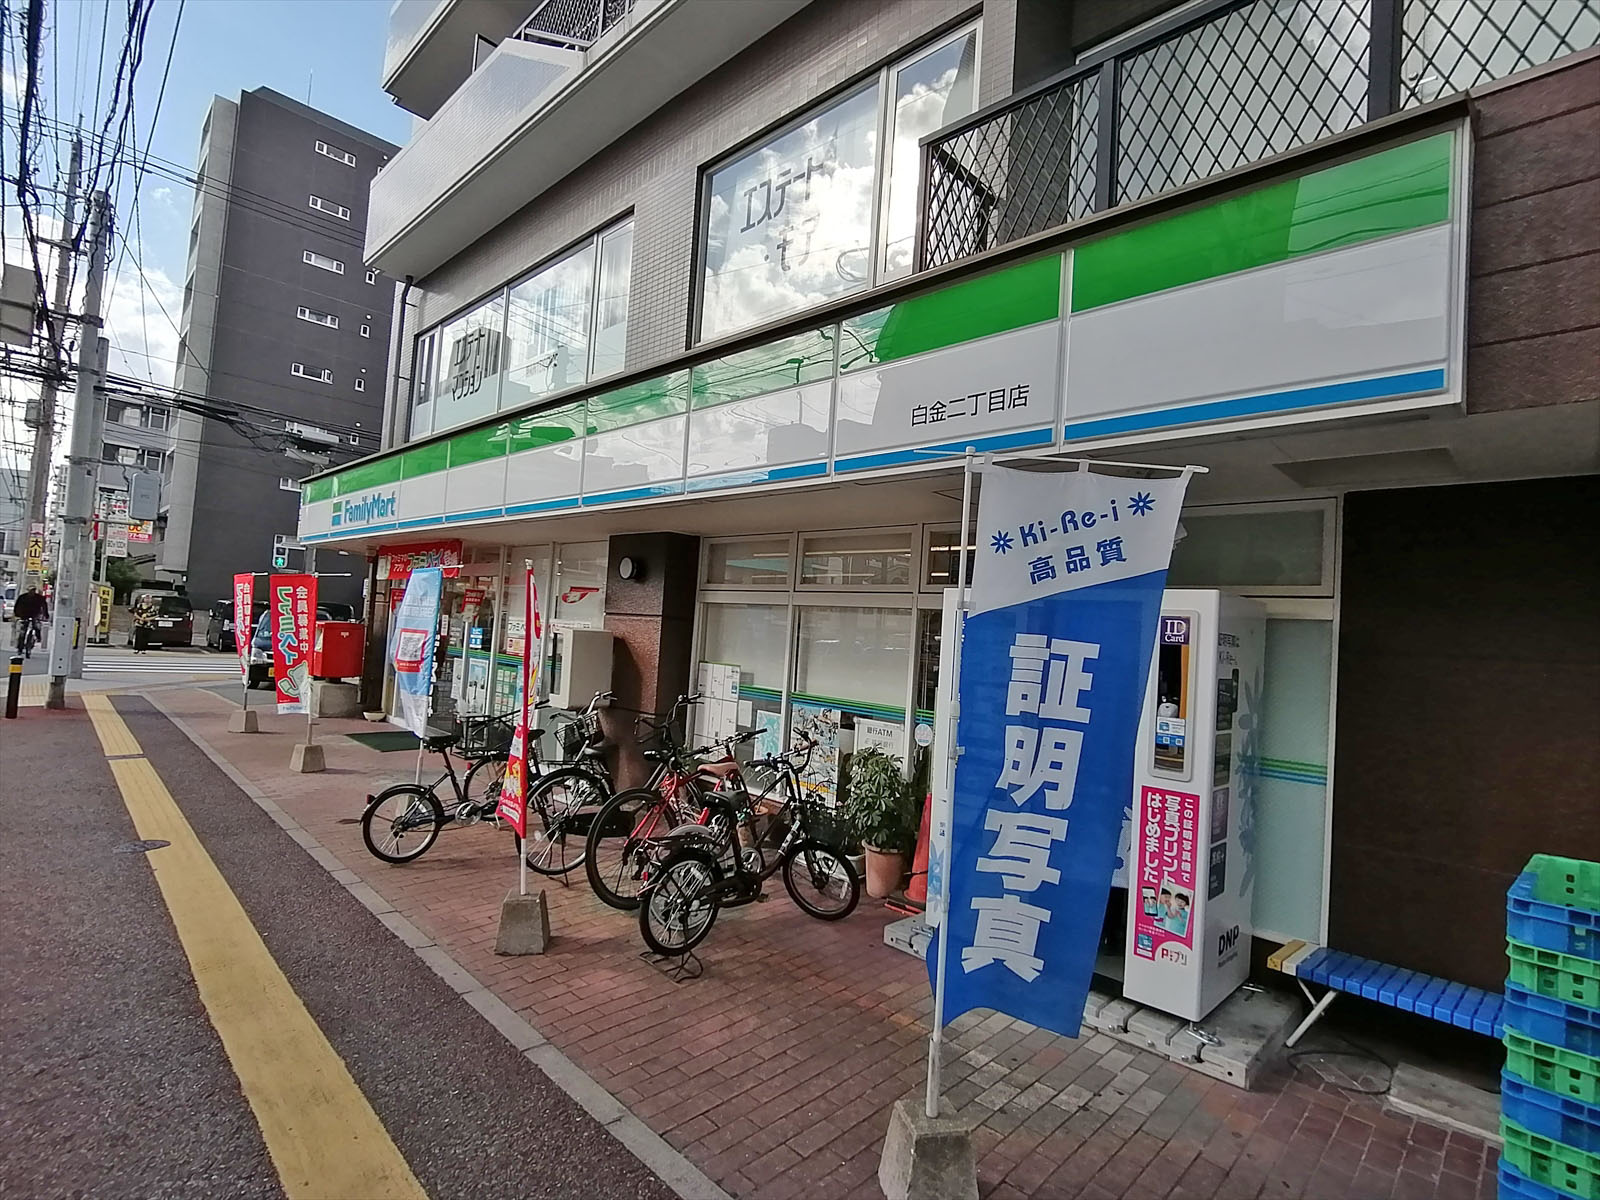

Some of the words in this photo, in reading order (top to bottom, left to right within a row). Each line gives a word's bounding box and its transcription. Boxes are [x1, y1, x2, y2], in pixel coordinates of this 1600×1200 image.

[911, 383, 1030, 427] 白金二丁目店
[343, 490, 397, 524] FamilyMart
[1018, 499, 1119, 548] Ki-Re-i
[29, 538, 42, 559] 大山
[1028, 536, 1128, 585] 高品質
[1164, 619, 1187, 635] ID
[1164, 633, 1185, 643] Card
[959, 633, 1100, 984] 証明写真
[1143, 791, 1163, 884] はじめました
[1162, 793, 1182, 886] 写真プリント
[1217, 924, 1240, 957] DNP
